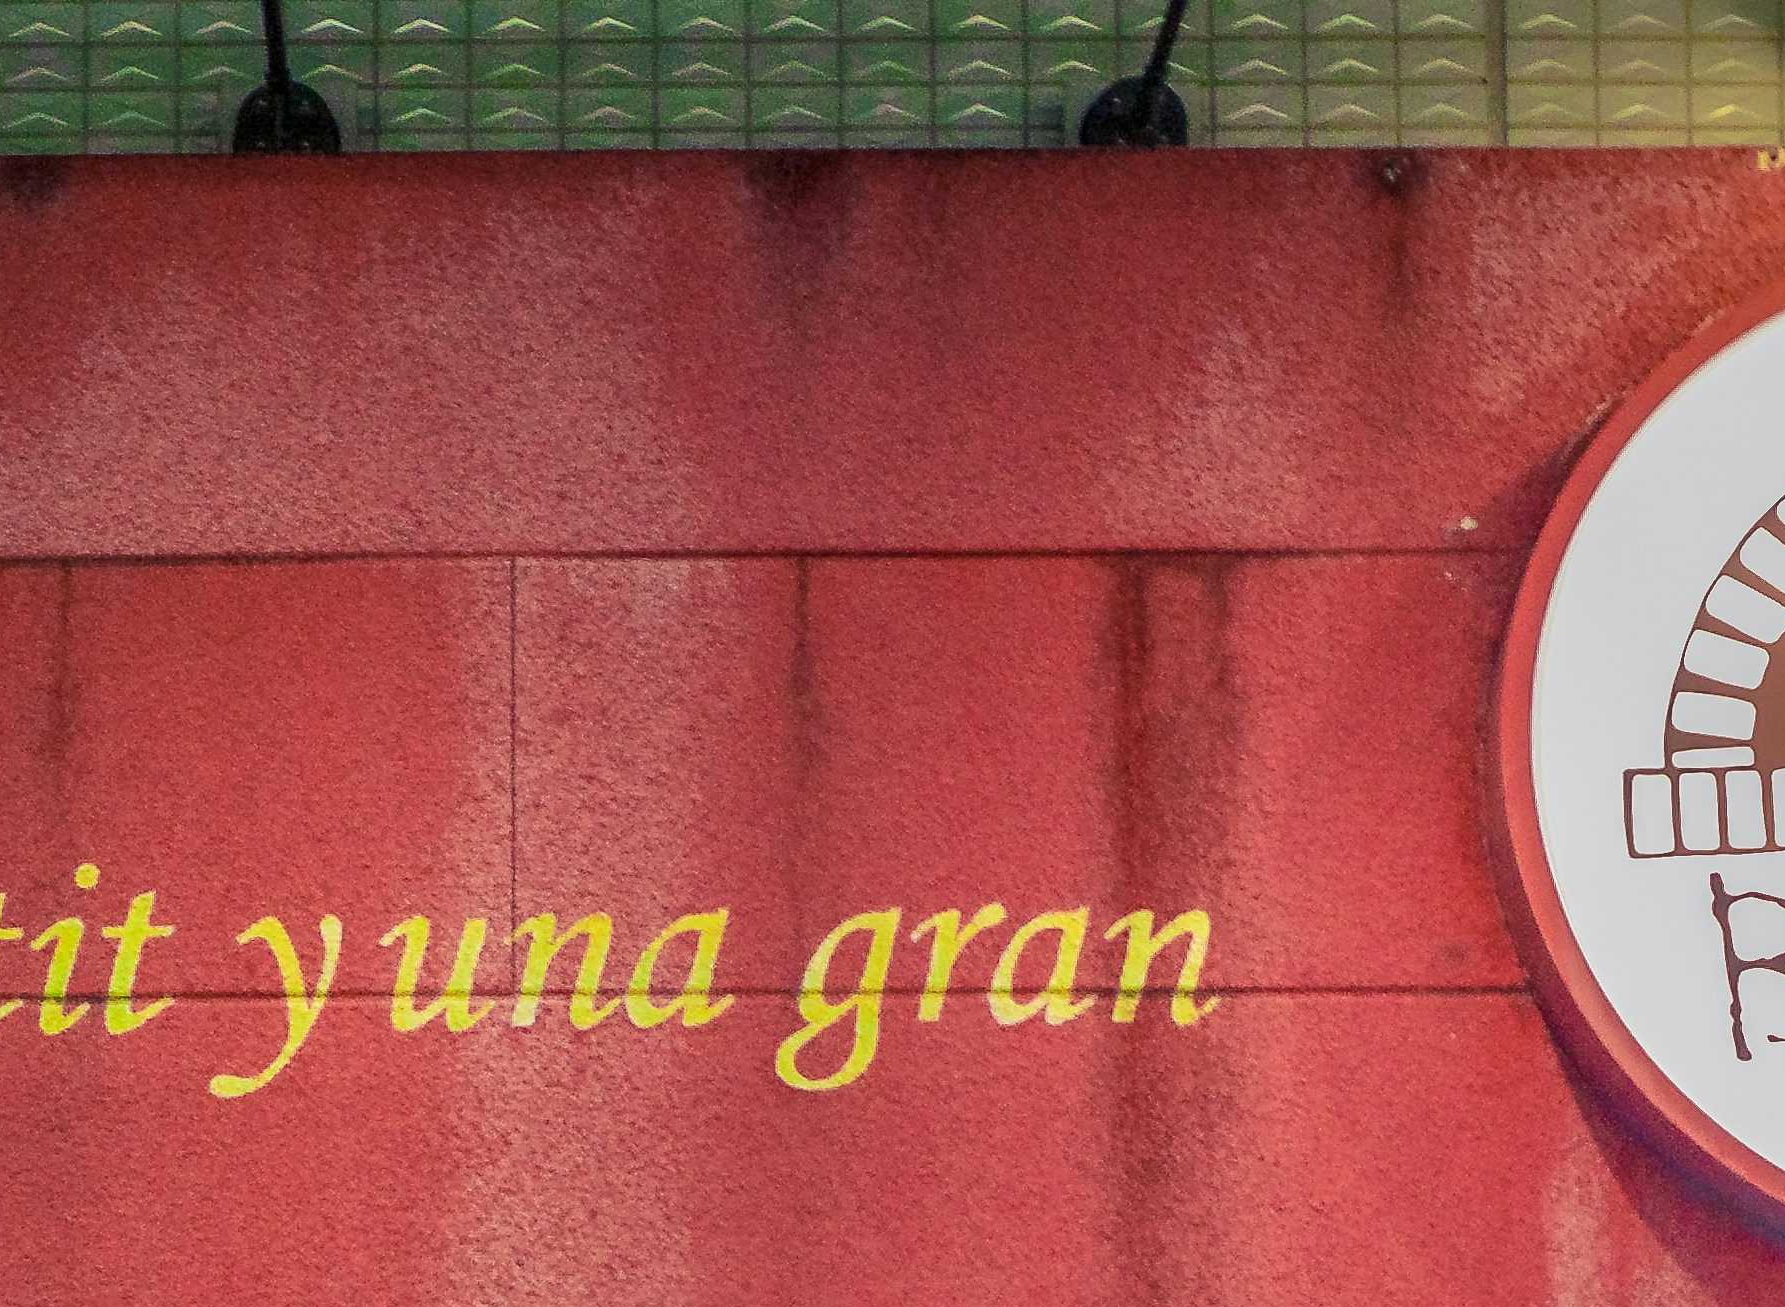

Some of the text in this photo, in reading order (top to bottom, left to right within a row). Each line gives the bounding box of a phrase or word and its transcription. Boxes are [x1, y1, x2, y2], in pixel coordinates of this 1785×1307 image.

[208, 913, 344, 1100] y
[379, 907, 736, 1034] una
[772, 901, 1221, 1093] gran
